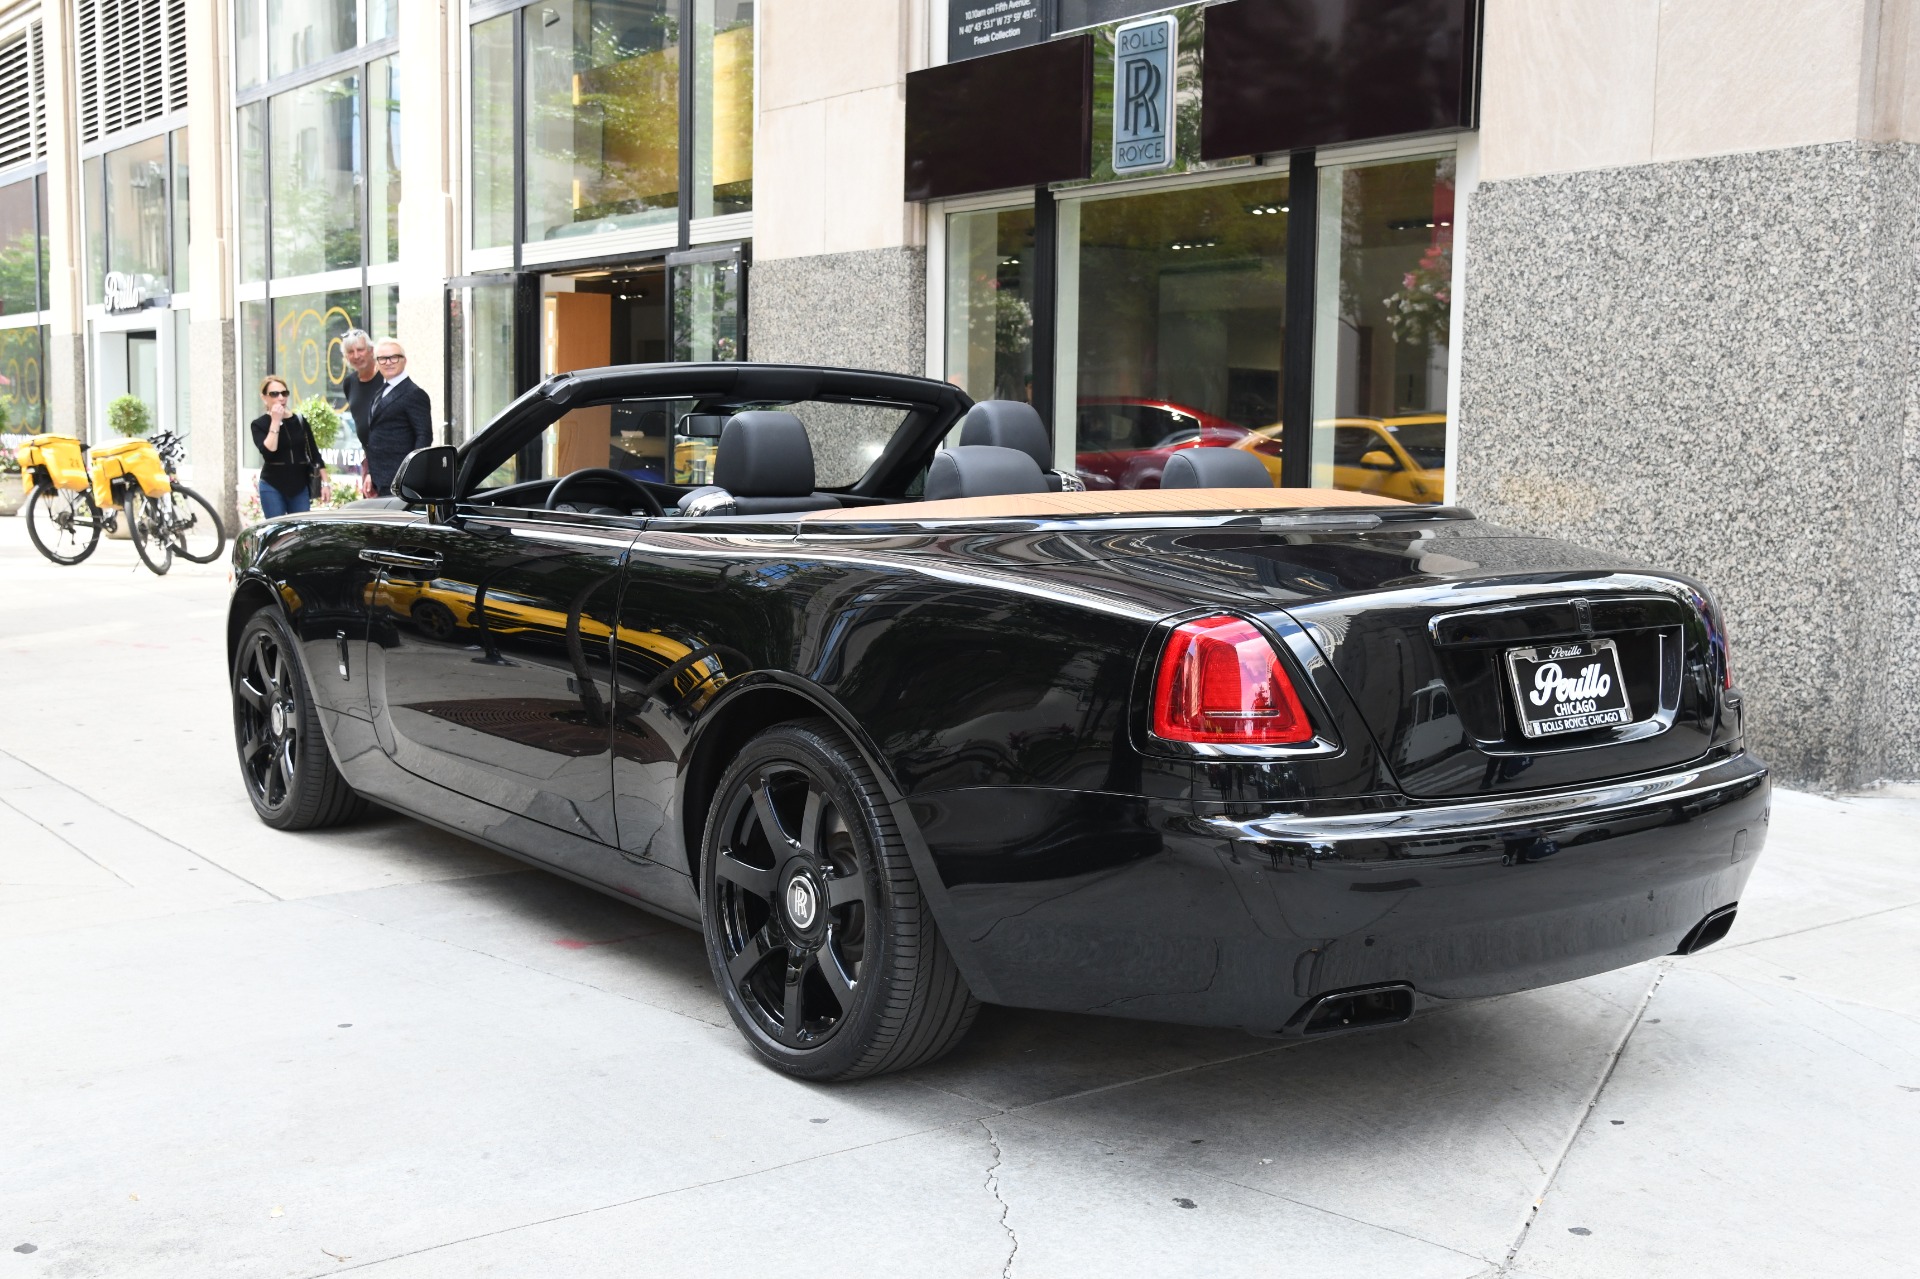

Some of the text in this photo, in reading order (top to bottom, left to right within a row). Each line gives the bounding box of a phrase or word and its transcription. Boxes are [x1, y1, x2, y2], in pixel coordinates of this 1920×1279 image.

[987, 7, 995, 15] on
[995, 2, 1008, 13] Fifth
[958, 26, 965, 36] N
[996, 17, 1003, 26] W
[973, 28, 1021, 46] Freak Collection
[1121, 28, 1165, 51] ROLLS
[1118, 142, 1162, 163] ROYCE
[1549, 645, 1582, 659] Perillo
[1529, 662, 1611, 706] Perillo
[1554, 699, 1597, 716] CHICAGO
[1542, 712, 1618, 732] ROLLS ROYCE CHICAGO
